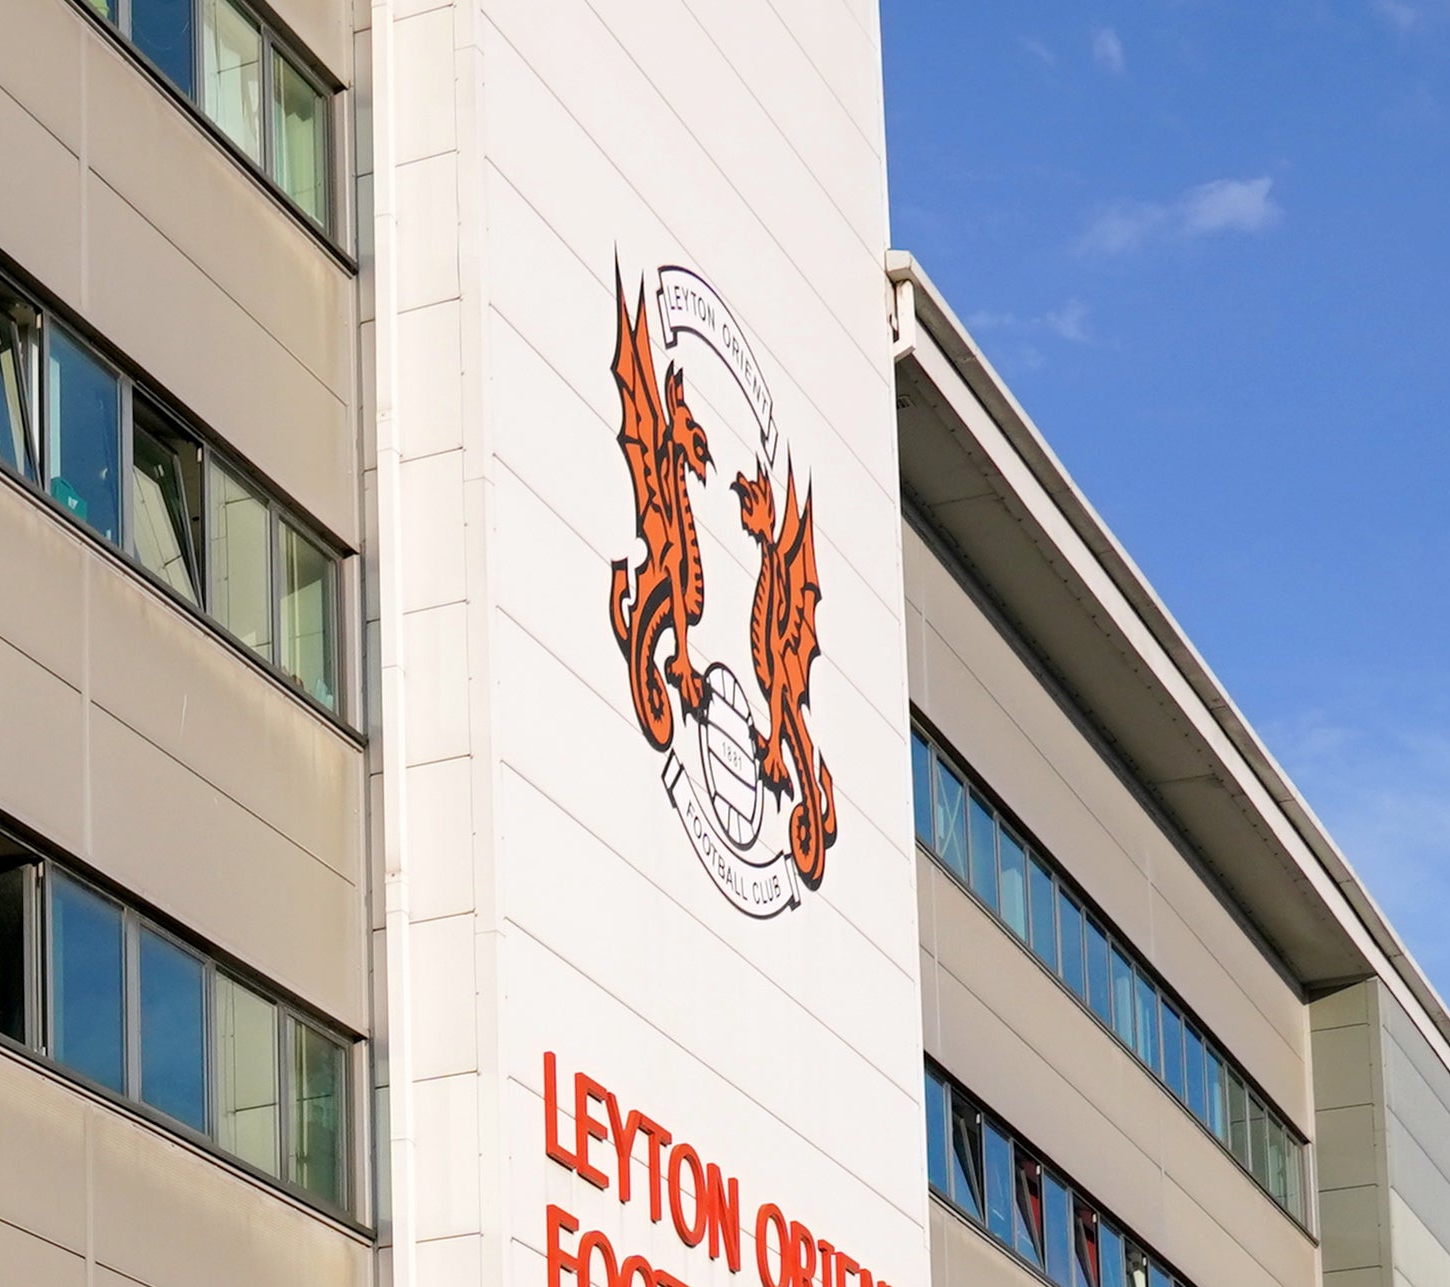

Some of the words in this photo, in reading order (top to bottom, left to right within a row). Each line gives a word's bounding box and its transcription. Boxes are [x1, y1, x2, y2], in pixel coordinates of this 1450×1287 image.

[666, 285, 716, 332] LEYTON
[722, 323, 769, 414] ORIENT
[685, 800, 748, 902] FOOTBALL
[752, 875, 782, 904] CLUB
[543, 1051, 742, 1273] LEYTON
